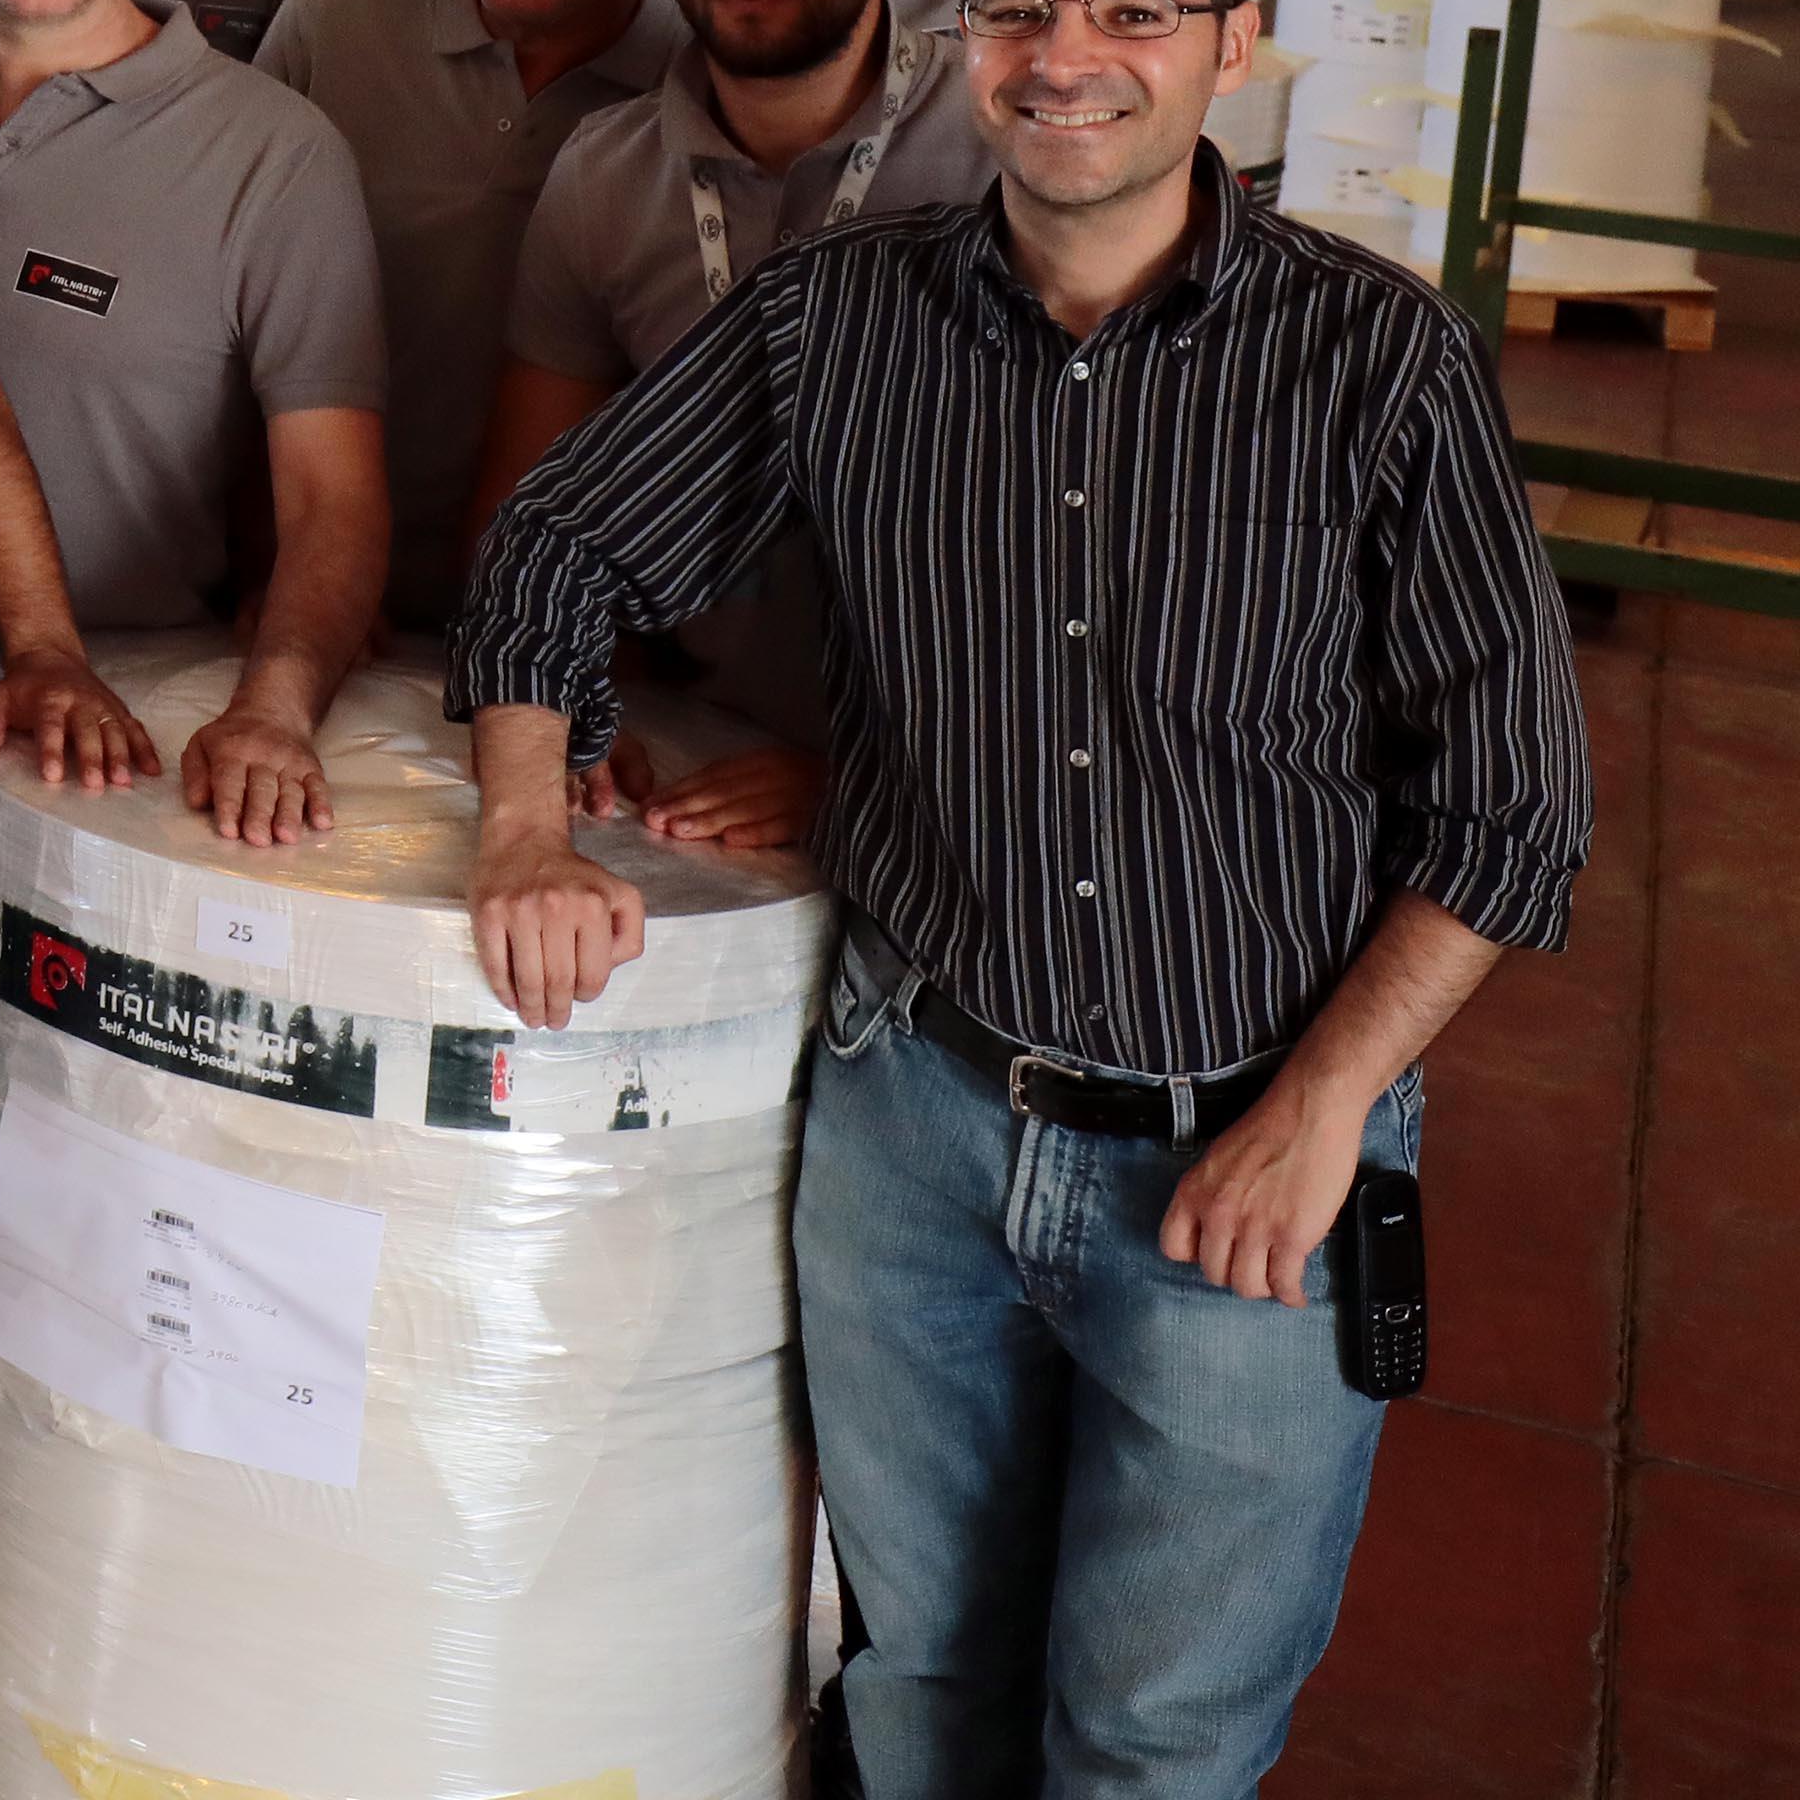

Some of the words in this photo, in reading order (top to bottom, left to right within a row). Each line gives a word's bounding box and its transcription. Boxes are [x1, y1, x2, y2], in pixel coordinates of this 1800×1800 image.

[51, 274, 102, 298] ITALNASTRI
[227, 920, 254, 943] 25
[127, 1028, 188, 1059] Adhesive
[189, 1045, 242, 1074] Special
[286, 1384, 314, 1405] 25
